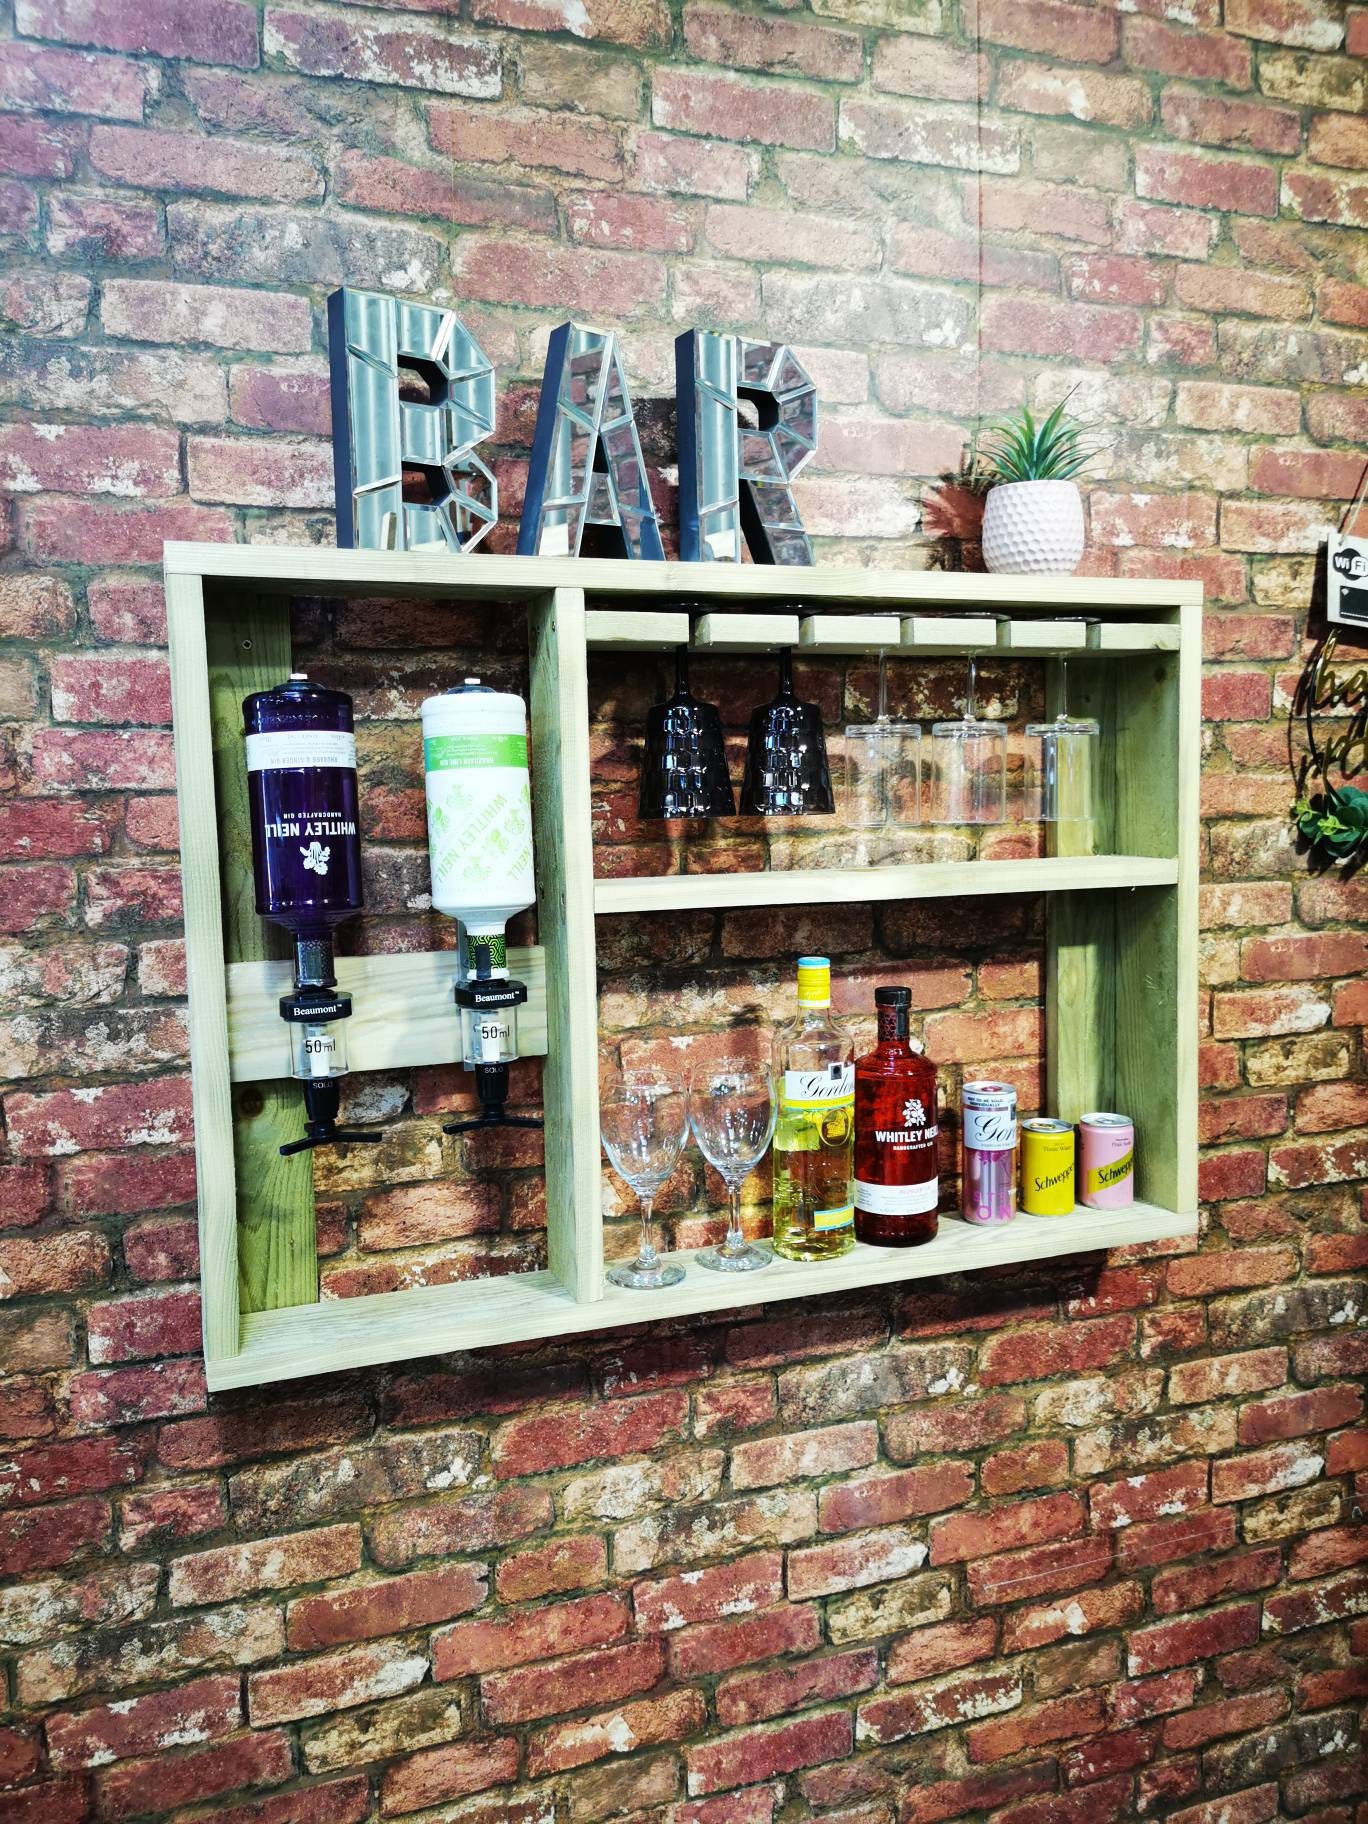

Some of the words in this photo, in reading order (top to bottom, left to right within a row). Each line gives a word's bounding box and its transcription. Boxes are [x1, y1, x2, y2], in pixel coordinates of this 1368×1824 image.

[327, 287, 816, 566] BAR
[265, 822, 300, 838] NEILL
[305, 821, 356, 836] WHITLEY
[459, 793, 508, 852] WHITLEY
[875, 1130, 923, 1143] WHITLEY
